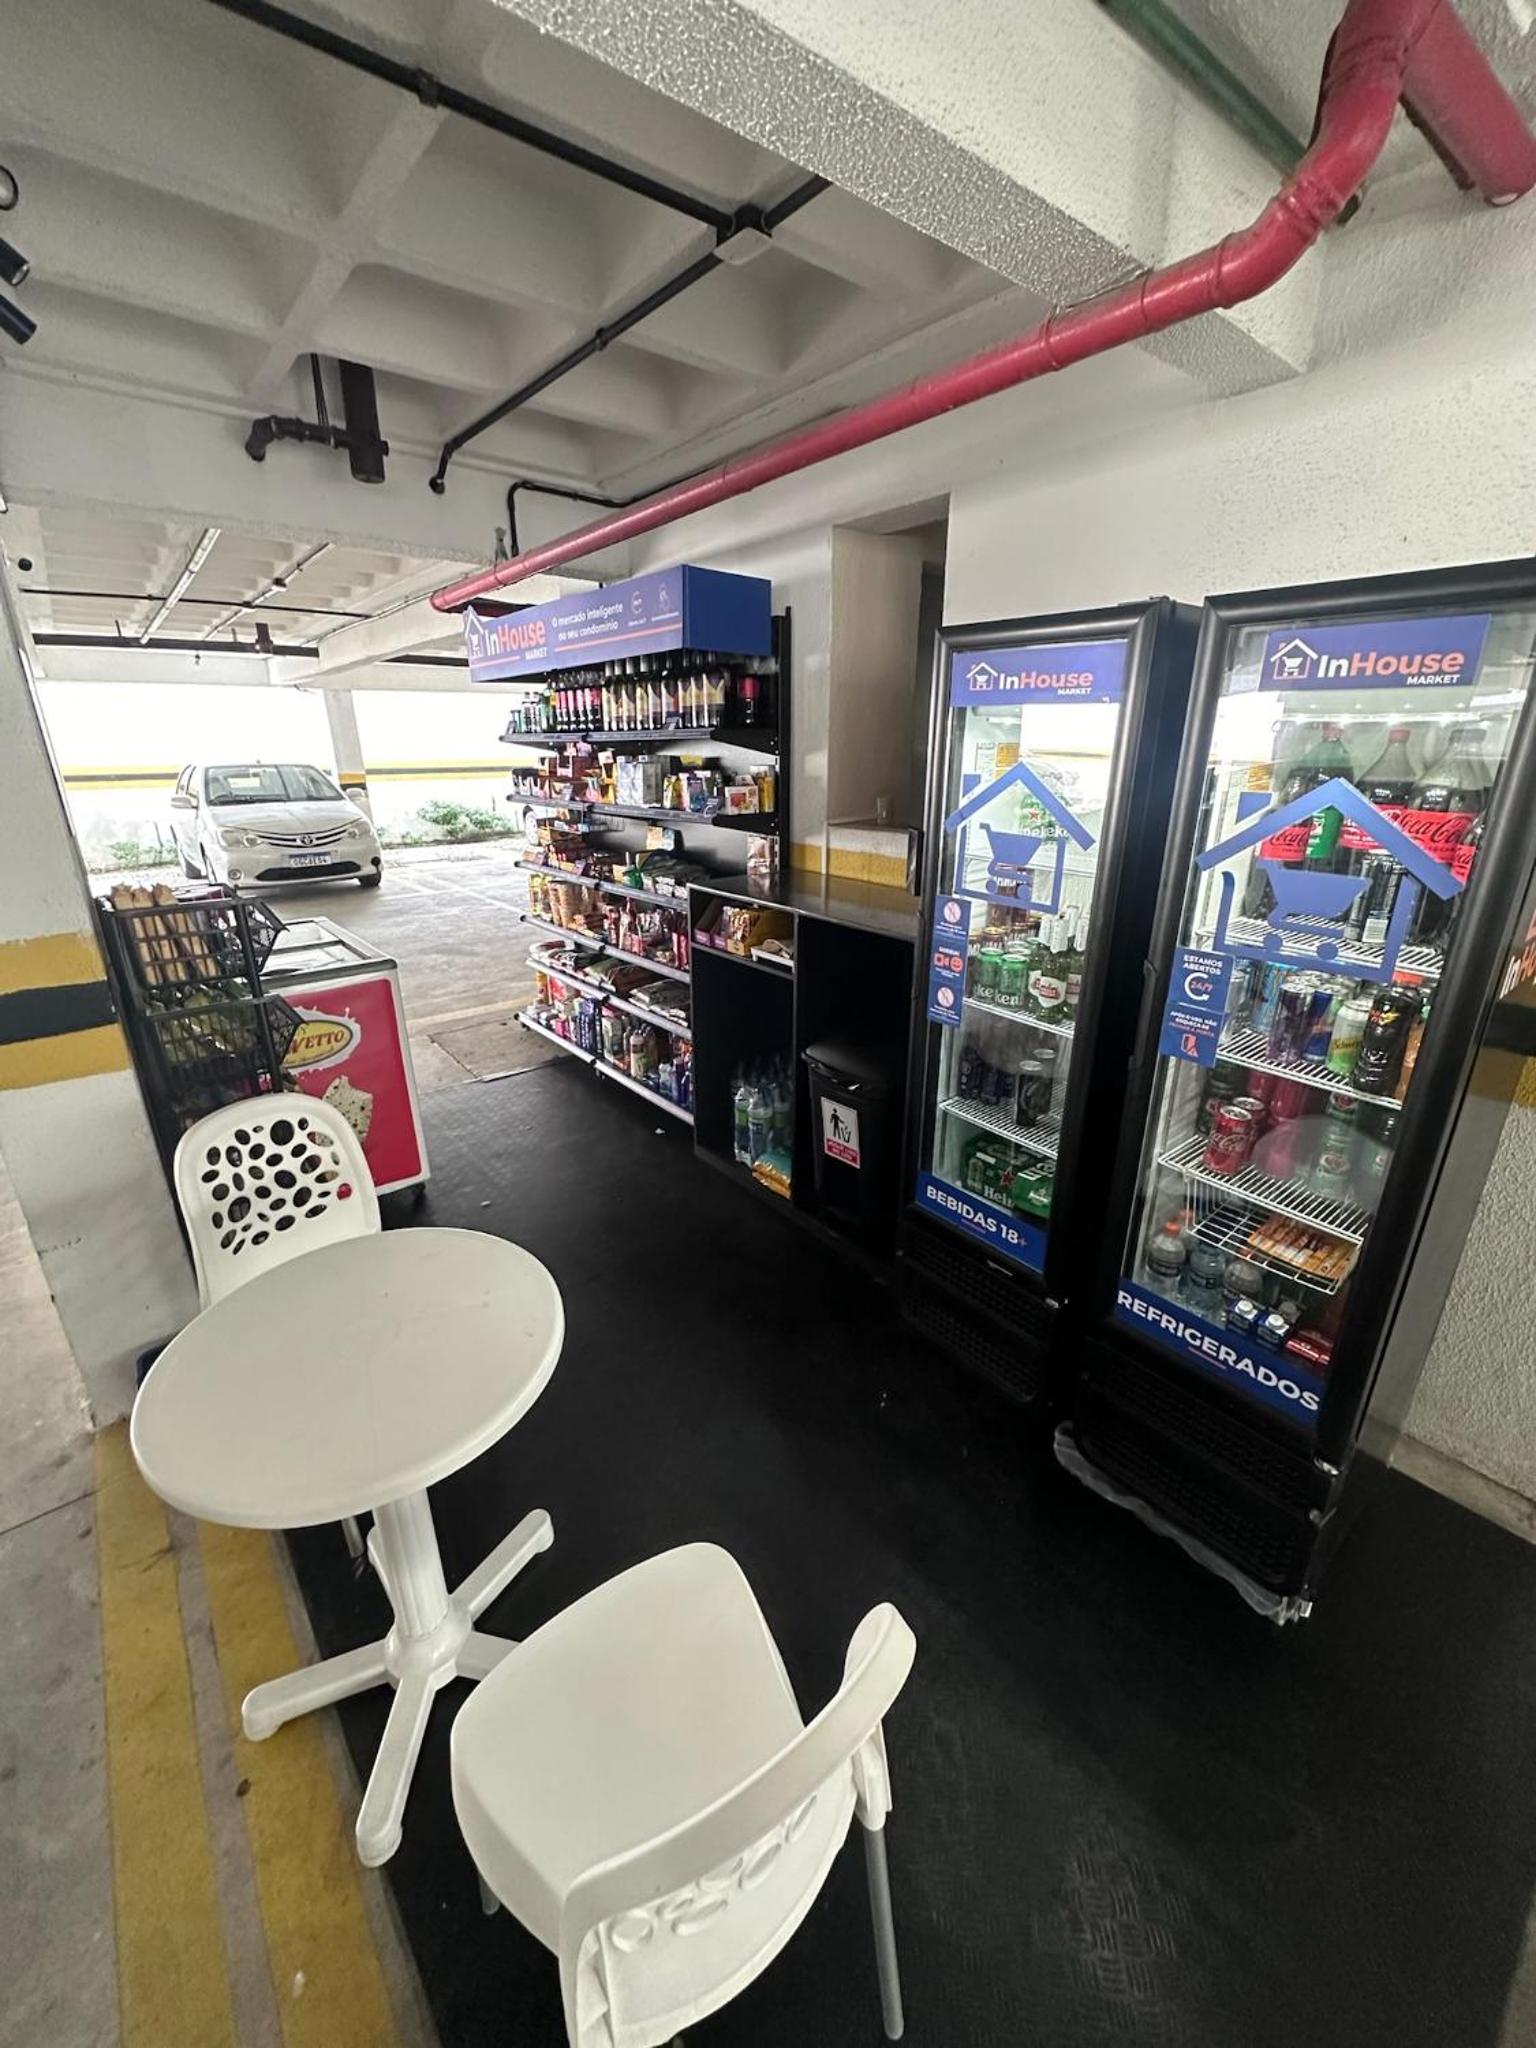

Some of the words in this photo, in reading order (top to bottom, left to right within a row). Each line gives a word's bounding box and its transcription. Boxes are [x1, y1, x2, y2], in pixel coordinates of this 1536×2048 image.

[558, 610, 586, 625] mercado
[587, 602, 623, 620] inteligente
[485, 621, 546, 656] InHouse
[525, 647, 547, 661] MARKET
[1317, 650, 1465, 679] InHouse
[999, 671, 1094, 690] InHouse
[1406, 674, 1461, 686] MARKET
[1057, 687, 1093, 696] MARKET
[1183, 954, 1223, 968] ESTAMOS
[1183, 962, 1222, 976] ABERTOS
[291, 1029, 345, 1054] VETTO
[926, 1185, 997, 1232] BEBIDAS
[1116, 1290, 1321, 1411] REFRIGERADOS
